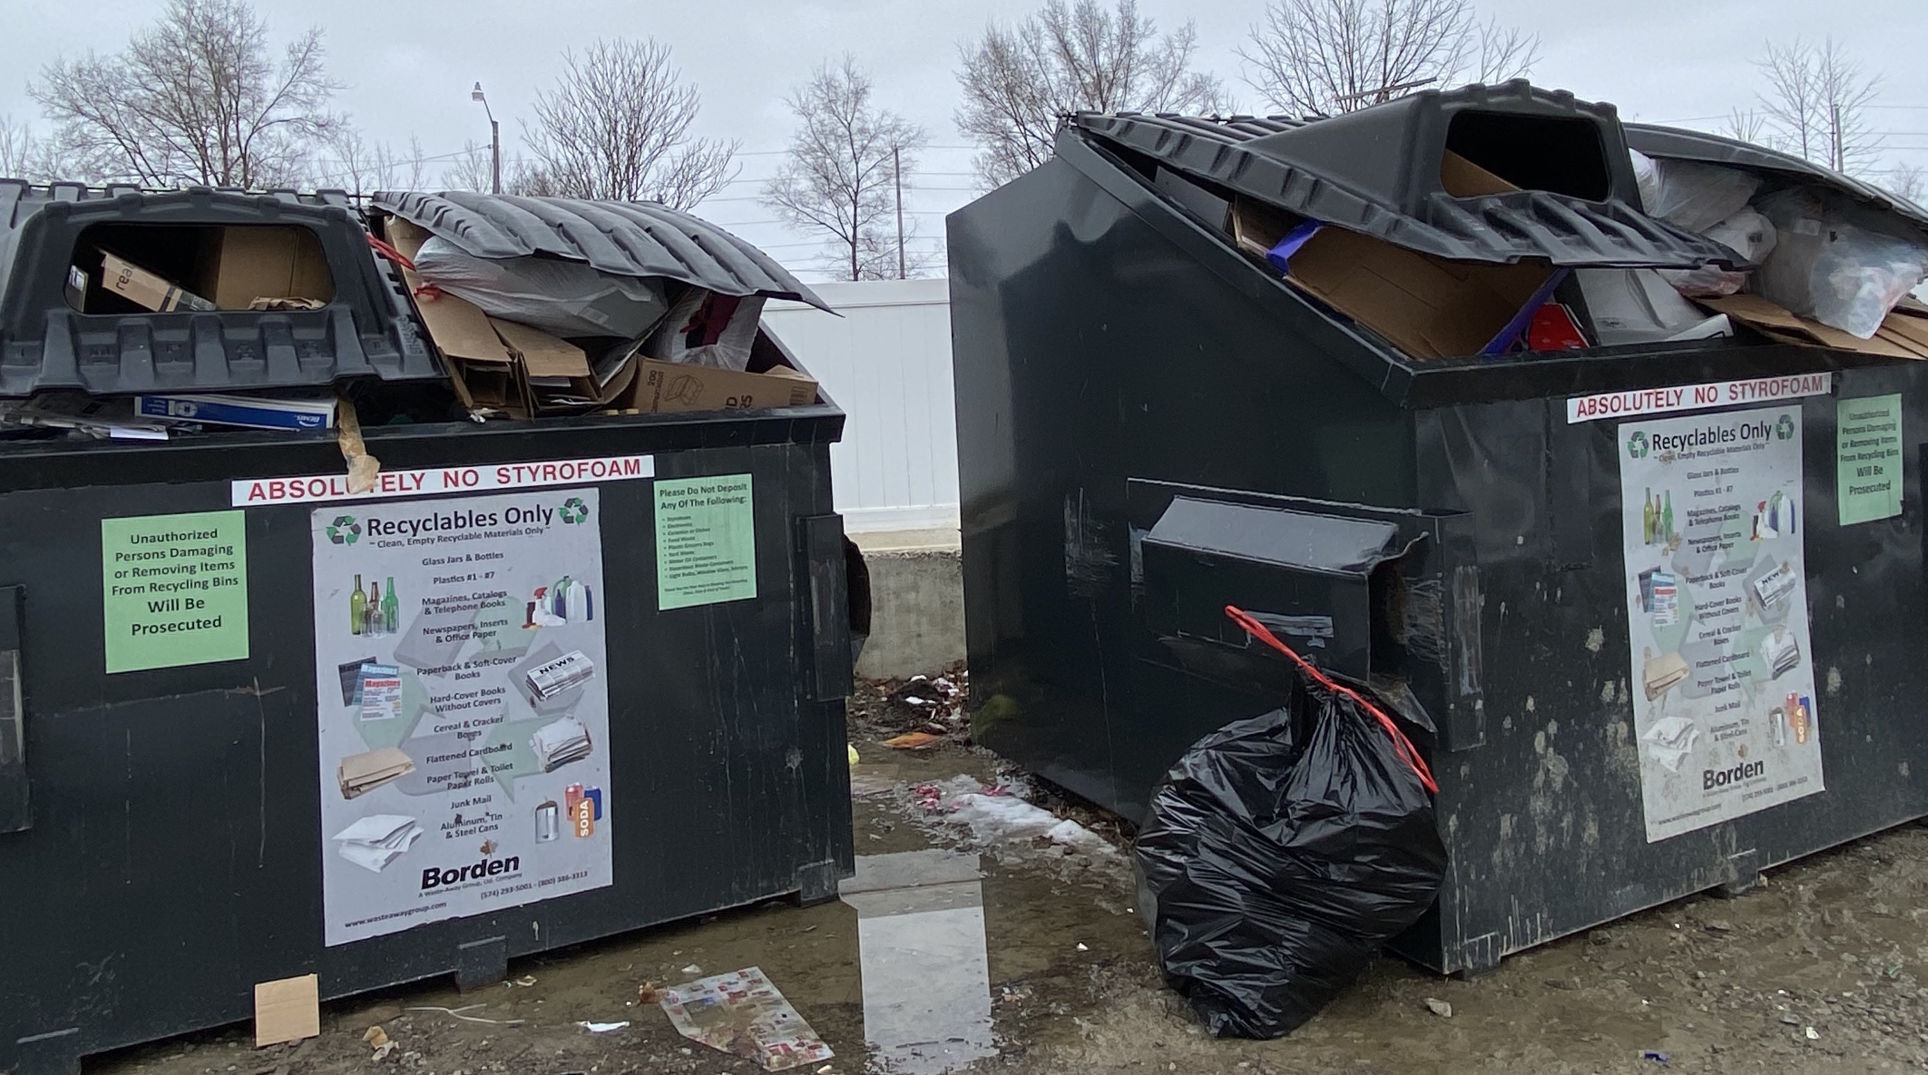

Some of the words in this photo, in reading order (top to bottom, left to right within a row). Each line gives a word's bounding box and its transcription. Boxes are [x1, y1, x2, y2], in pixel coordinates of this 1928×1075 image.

[1577, 389, 1684, 418] ABSOLUTELY
[1695, 386, 1718, 404] NO
[1729, 376, 1823, 400] STYROFOAM
[1652, 426, 1736, 452] Recyclables
[1740, 420, 1772, 441] Only
[1856, 465, 1872, 477] Will
[1873, 465, 1884, 476] Be
[248, 472, 426, 501] ABSOLELY
[443, 469, 479, 488] NO
[496, 459, 641, 484] STYROFOAM
[1849, 480, 1891, 496] Prosecuted
[659, 489, 685, 497] Please
[687, 487, 698, 495] Do
[700, 486, 716, 494] Not
[717, 483, 747, 493] Deposit
[660, 502, 677, 510] Any
[678, 499, 688, 508] Of
[689, 499, 705, 507] The
[367, 509, 498, 538] Recyclables
[505, 504, 553, 525] Only
[130, 528, 219, 545] Unauthorized
[377, 538, 405, 549] Clean,
[407, 535, 435, 547] Empty
[437, 531, 482, 543] Recyclable
[483, 528, 523, 539] Materials
[525, 526, 544, 536] Only
[115, 550, 166, 562] Persons
[170, 544, 233, 558] Damaging
[422, 558, 445, 566] Glass
[447, 556, 463, 564] Jars
[474, 552, 504, 561] Bottles
[114, 570, 128, 579] or
[132, 563, 197, 578] Removing
[200, 561, 235, 572] Items
[433, 575, 465, 584] Plastics
[467, 573, 477, 581] #1
[484, 571, 495, 579] #7
[112, 584, 145, 596] From
[149, 579, 209, 593] Recycling
[212, 576, 239, 587] Bins
[147, 598, 180, 613] Will
[185, 598, 205, 610] Be
[422, 594, 470, 606] Magazines,
[471, 590, 507, 600] Catalogs
[424, 607, 432, 615] &
[434, 603, 478, 614] Telephone
[480, 600, 506, 609] Books
[131, 615, 222, 636] Prosecuted
[423, 623, 478, 635] Newspapers,
[480, 619, 508, 628] Inserts
[445, 633, 470, 642] Office
[472, 630, 496, 639] Paper
[416, 663, 462, 676] Paperback
[473, 656, 517, 668] Soft-Cover
[539, 657, 575, 674] NEWS
[455, 671, 481, 680] Books
[430, 690, 478, 704] Hard-Cover
[480, 686, 506, 697] Books
[435, 701, 471, 713] Without
[473, 697, 501, 708] Covers
[433, 722, 461, 733] Cereal
[463, 720, 470, 728] &
[472, 714, 504, 727] Cracker
[426, 750, 467, 764] Flattened
[426, 774, 452, 784] Paper
[454, 767, 479, 779] Towel
[481, 766, 488, 774] &
[490, 762, 513, 773] Toilet
[1703, 760, 1764, 790] Borden
[447, 780, 472, 790] Paper
[474, 776, 494, 785] Rolls
[450, 800, 470, 810] Junk
[472, 795, 492, 806] Mail
[490, 813, 503, 821] Tin
[580, 800, 589, 837] SODA
[446, 831, 453, 839] &
[455, 827, 476, 837] Steel
[478, 823, 498, 833] Cans
[421, 855, 520, 890] Borden
